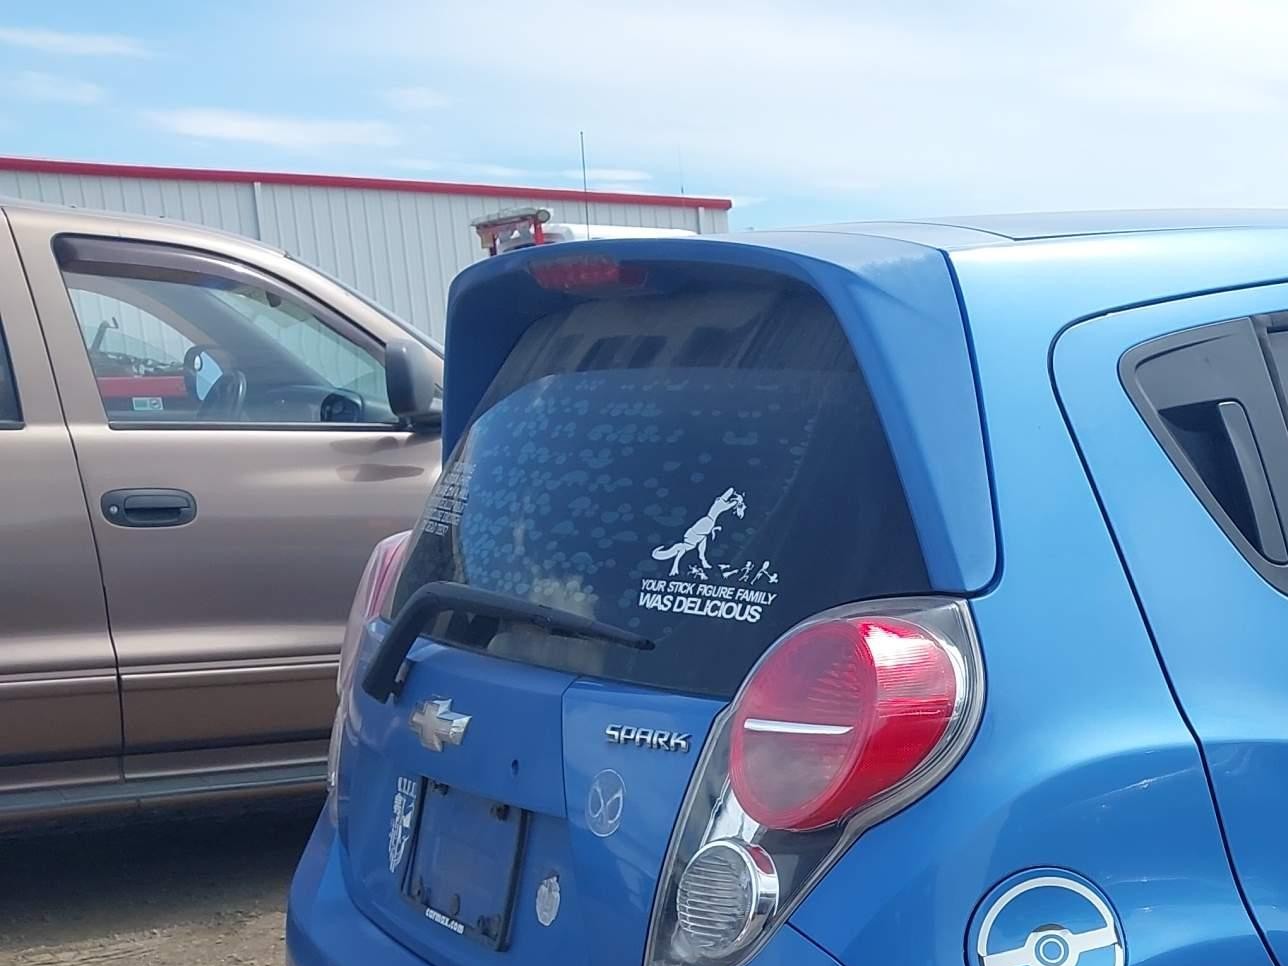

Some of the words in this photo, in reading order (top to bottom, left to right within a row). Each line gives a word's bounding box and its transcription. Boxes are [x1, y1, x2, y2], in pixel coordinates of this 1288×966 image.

[641, 580, 666, 592] YOUR
[667, 581, 696, 594] STICK
[697, 584, 735, 599] FIGURE
[735, 588, 776, 604] FAMILY
[639, 593, 673, 611] WAS
[674, 597, 762, 622] DELICIOUS
[605, 724, 692, 752] SPARK
